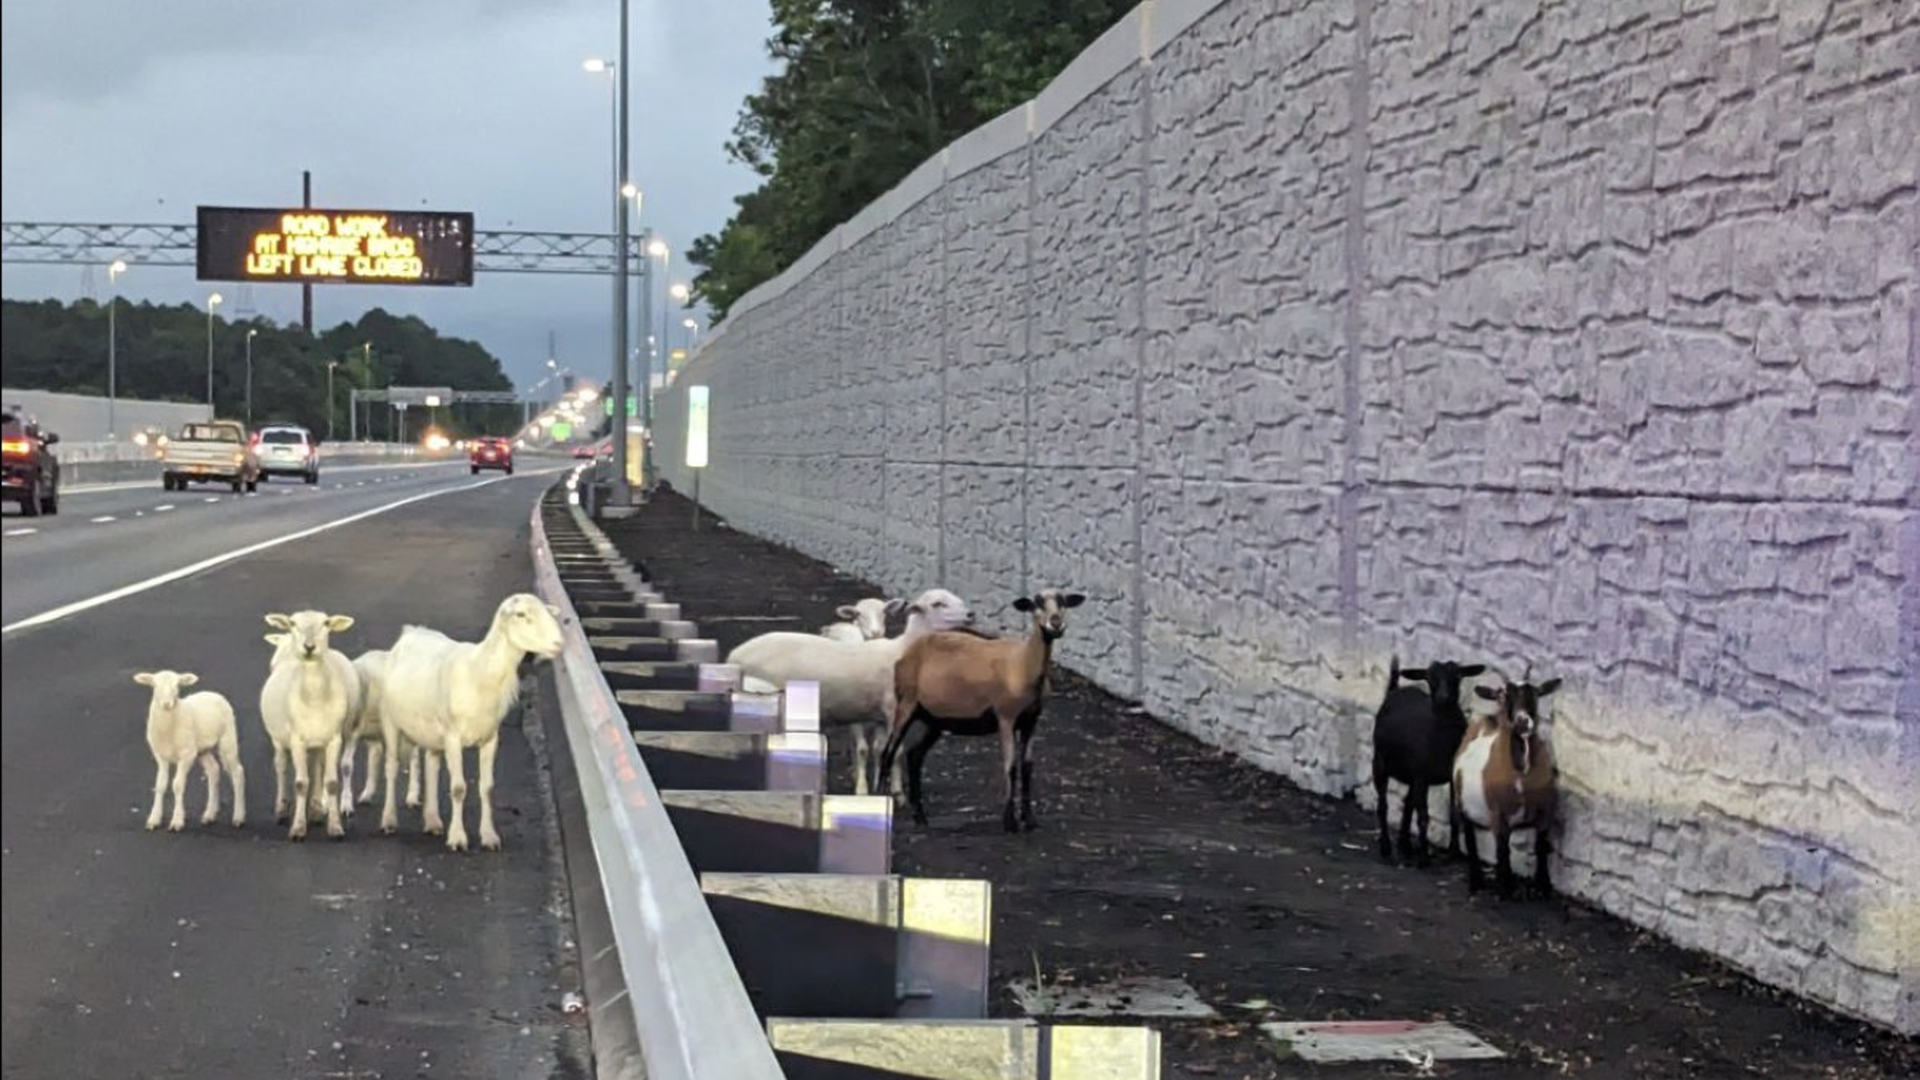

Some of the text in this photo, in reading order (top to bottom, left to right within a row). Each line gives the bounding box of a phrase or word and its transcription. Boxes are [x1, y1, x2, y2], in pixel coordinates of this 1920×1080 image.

[282, 215, 387, 237] ROAD WORK
[256, 235, 280, 254] AT
[248, 254, 422, 277] LEFT LANE CLOSED
